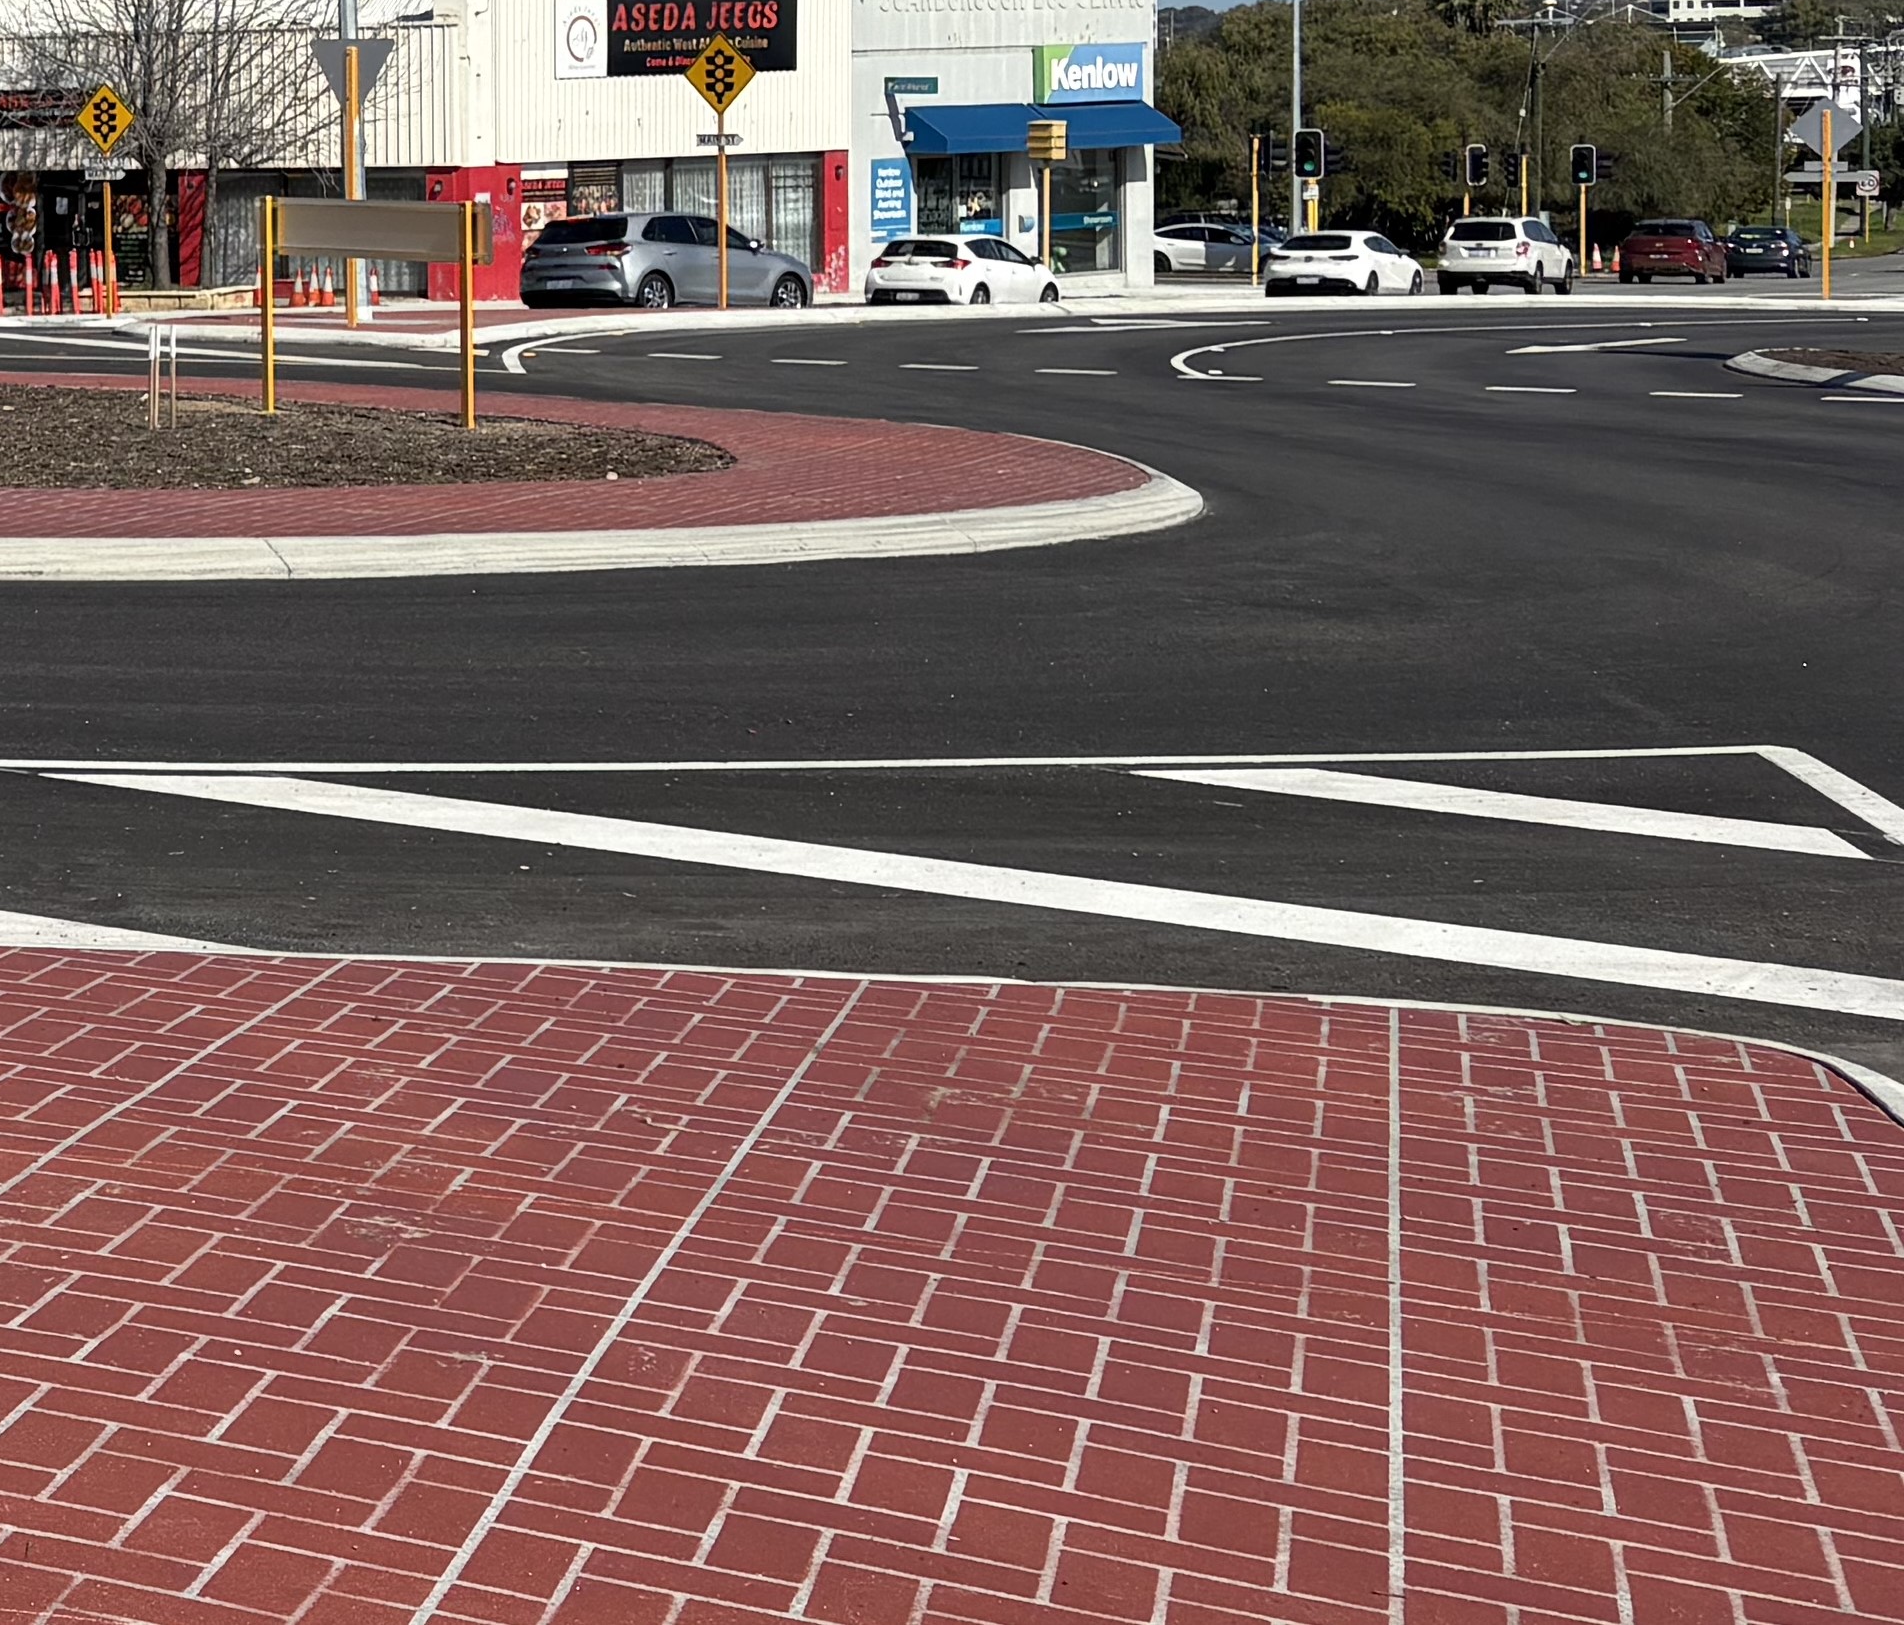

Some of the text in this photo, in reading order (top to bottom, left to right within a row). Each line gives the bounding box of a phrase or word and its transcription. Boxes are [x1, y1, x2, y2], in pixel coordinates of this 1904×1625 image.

[611, 1, 696, 33] ASEDA
[705, 0, 779, 31] JEEGS
[623, 37, 671, 53] Authentic
[673, 37, 697, 52] West
[735, 35, 769, 50] Cuisine
[1049, 55, 1138, 92] Kenlow
